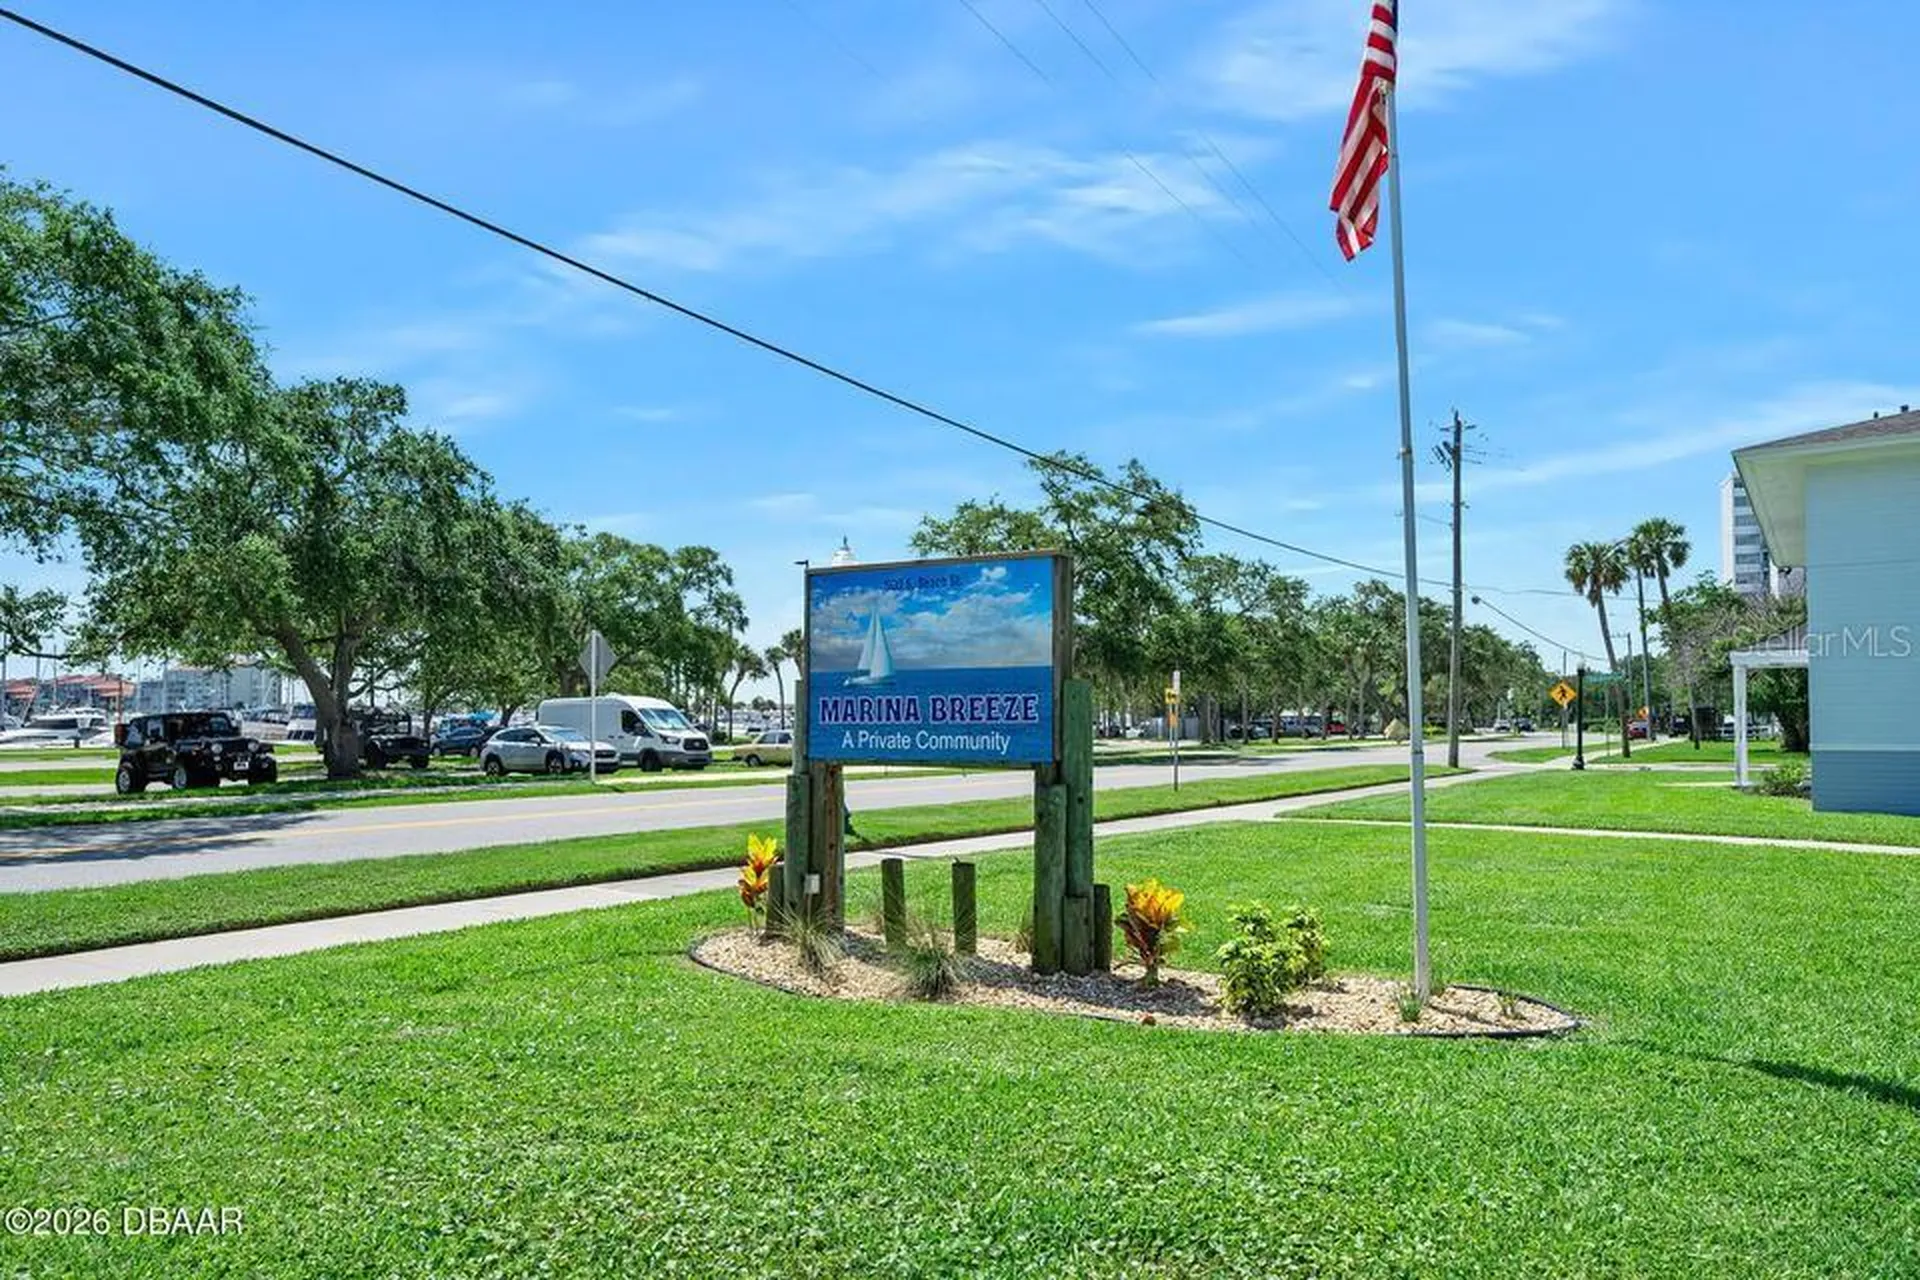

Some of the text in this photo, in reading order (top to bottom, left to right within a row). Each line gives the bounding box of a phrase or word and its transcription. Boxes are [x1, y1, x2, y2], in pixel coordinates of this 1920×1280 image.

[820, 693, 1039, 724] MARINA BREEZE
[841, 730, 1011, 755] A Private Community
